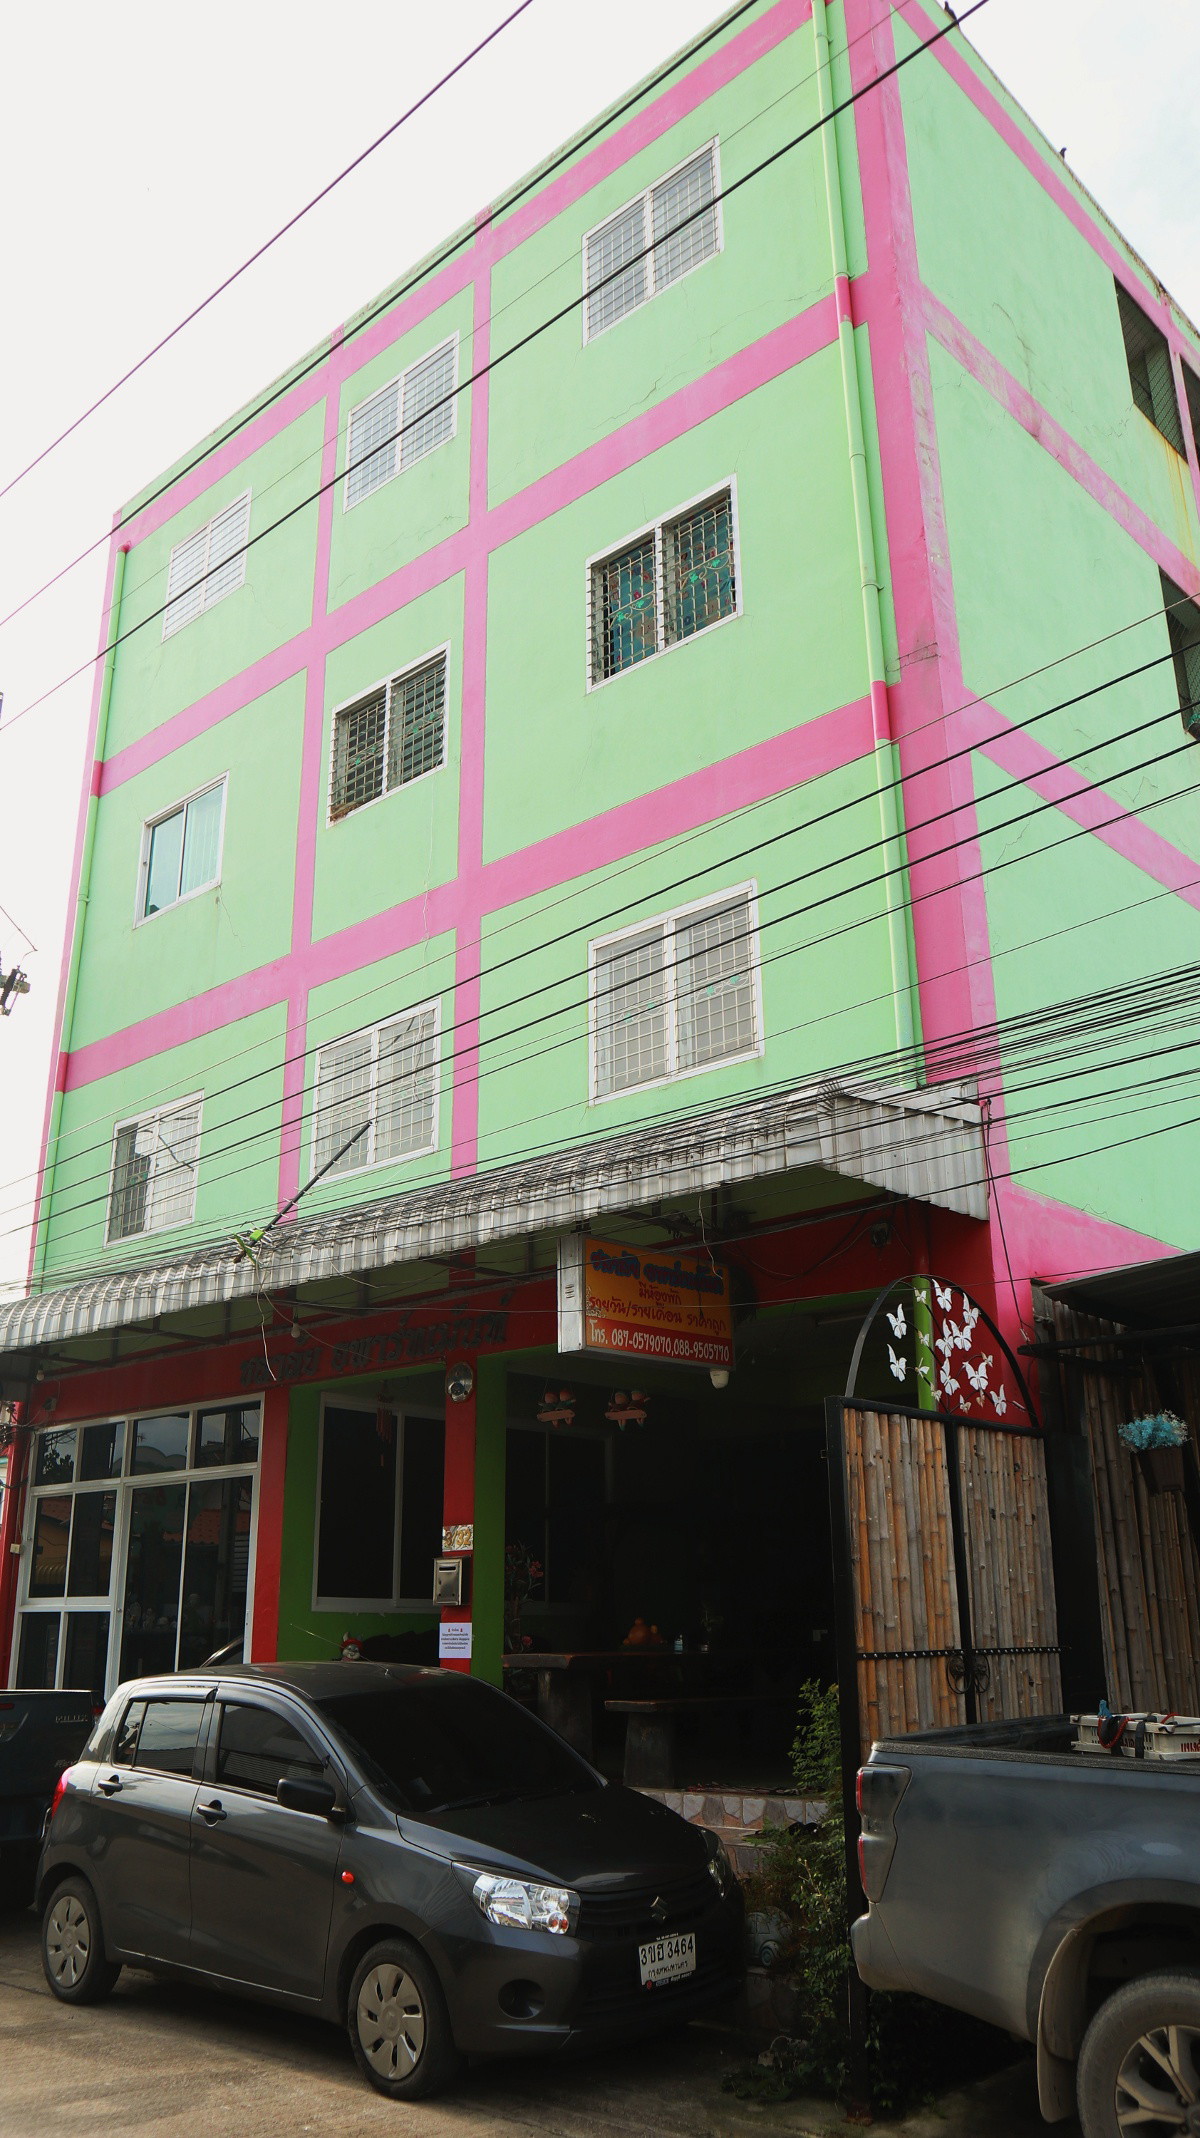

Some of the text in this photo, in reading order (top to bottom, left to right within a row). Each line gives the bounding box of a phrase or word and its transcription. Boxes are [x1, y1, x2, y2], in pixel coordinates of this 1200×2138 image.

[638, 1282, 682, 1305] มีห้องพัก
[588, 1296, 683, 1323] รายวัน/รายเดือน
[589, 1319, 608, 1344] โทร.
[667, 1936, 693, 1958] 3464
